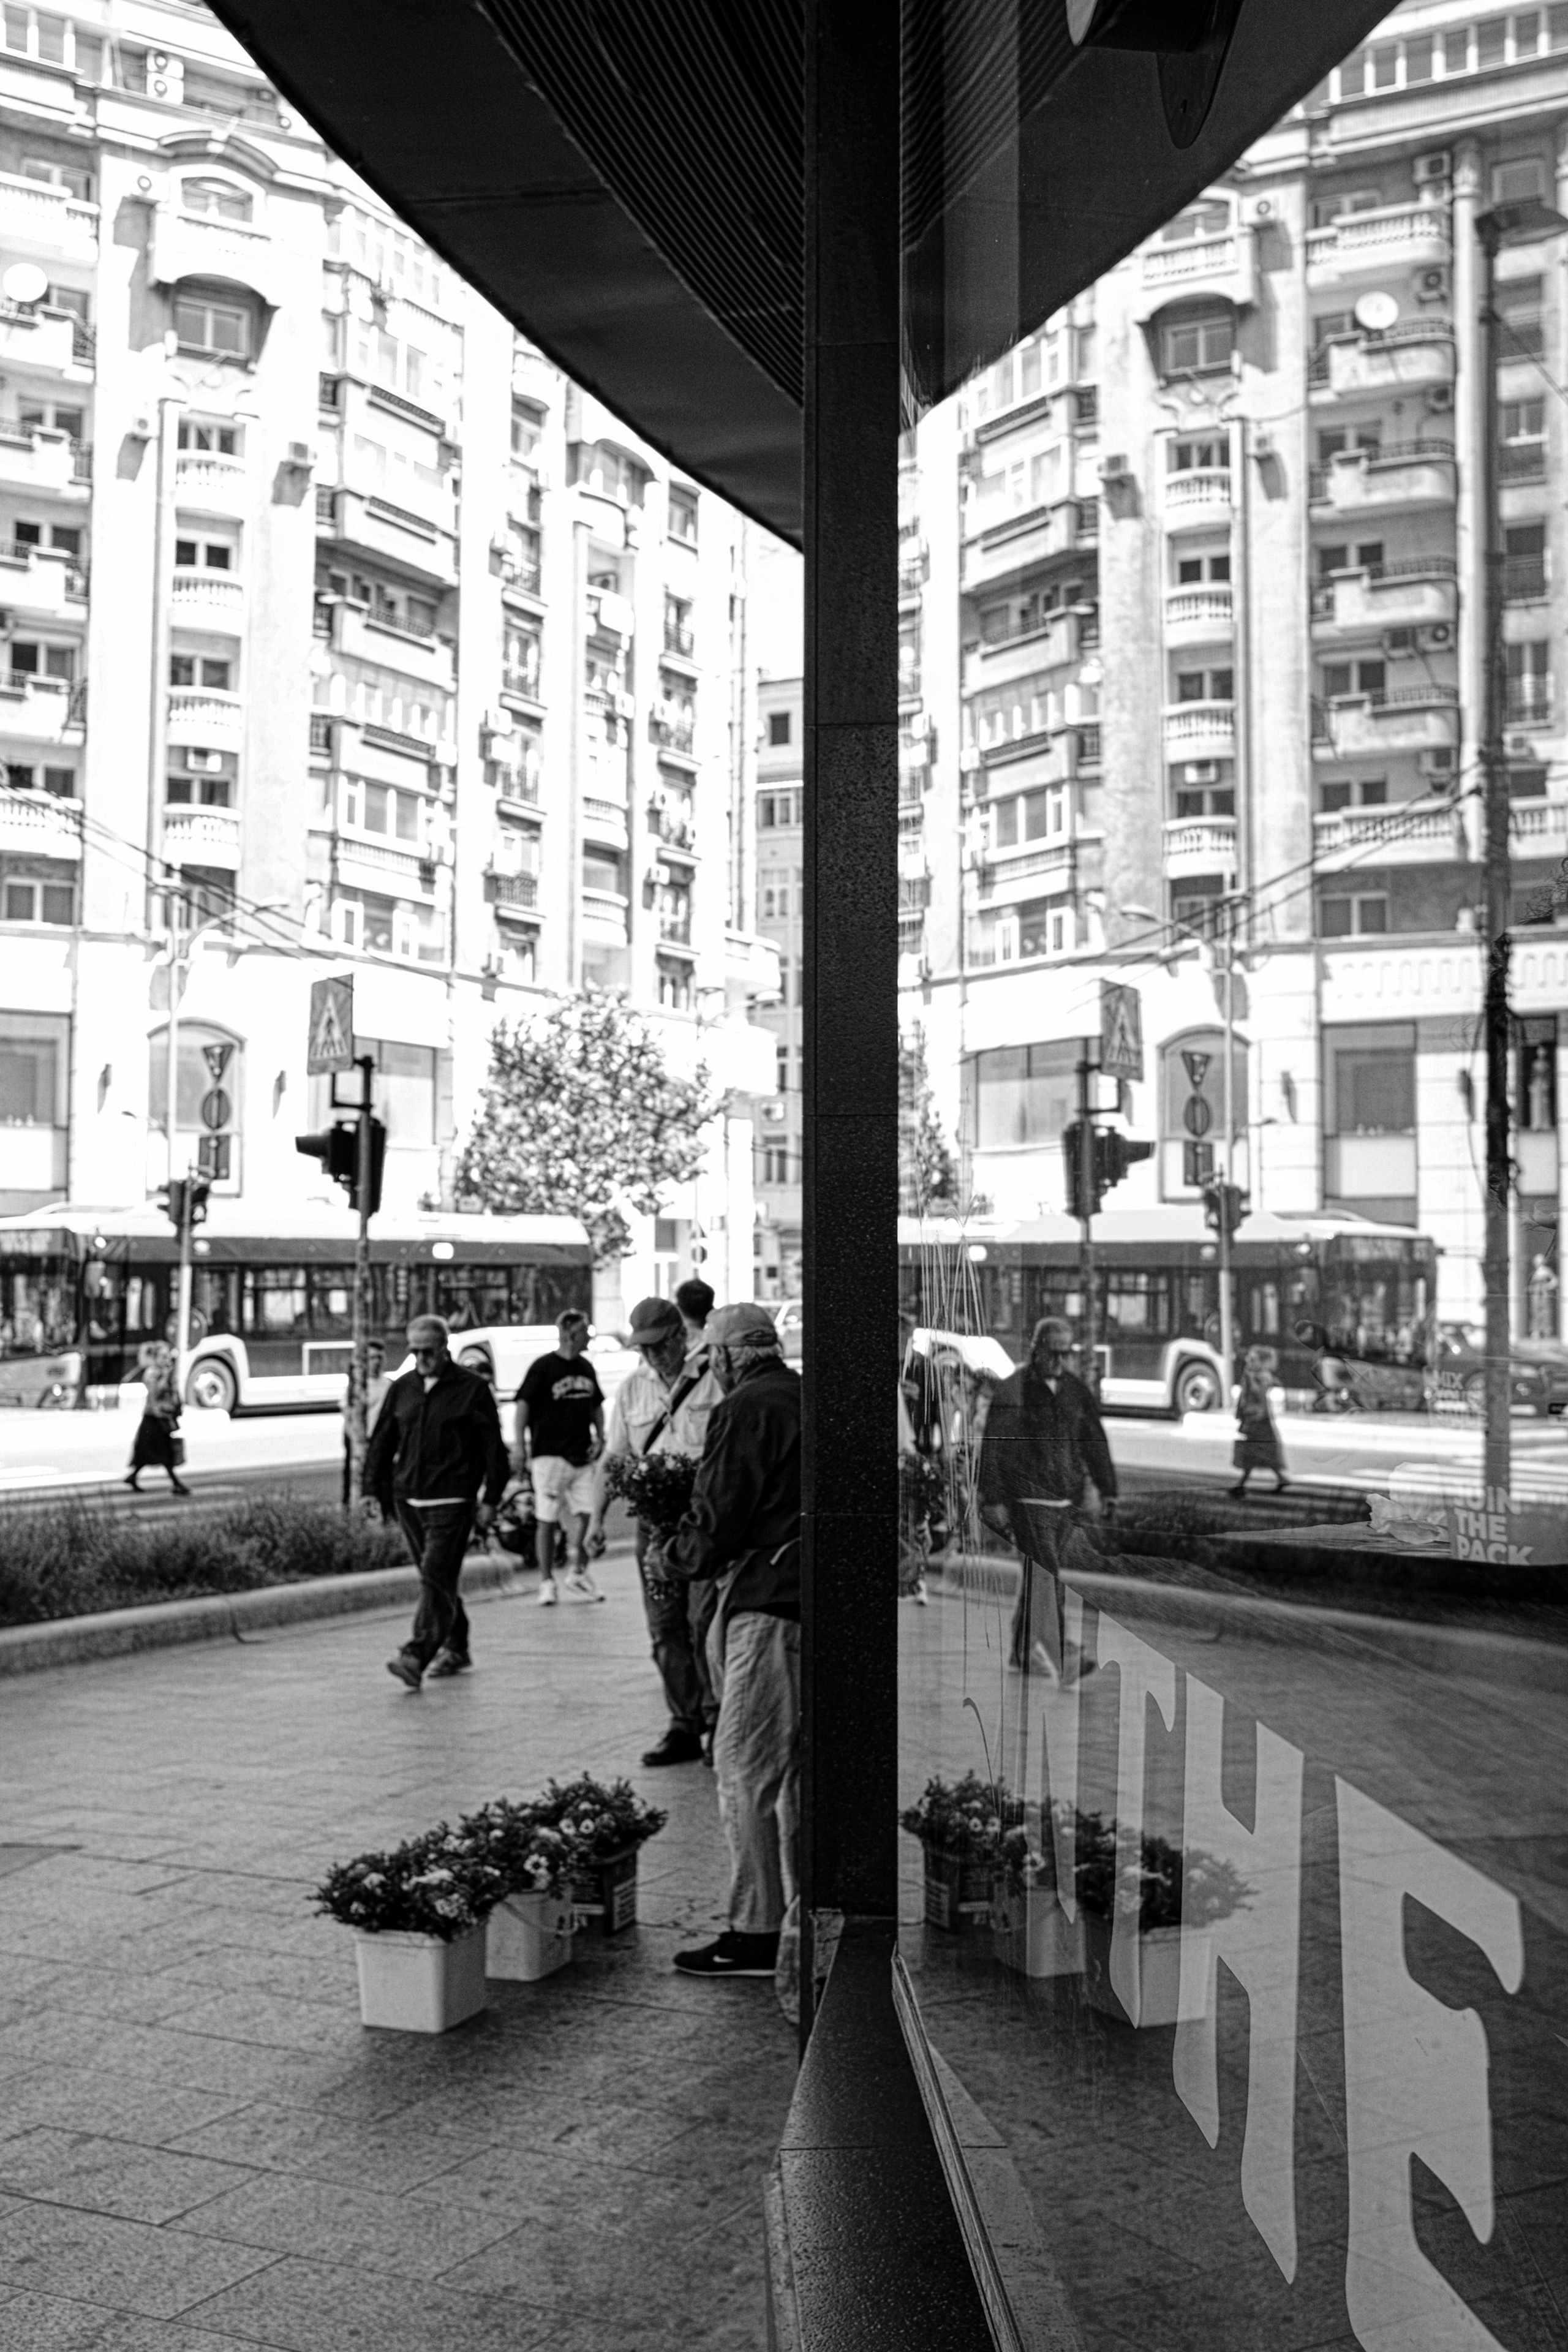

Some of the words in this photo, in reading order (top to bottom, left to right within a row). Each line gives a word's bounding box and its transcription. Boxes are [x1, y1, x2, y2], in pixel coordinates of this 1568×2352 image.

[1453, 1507, 1508, 1543] THE
[1456, 1534, 1534, 1566] PACK
[1097, 1610, 1525, 2351] THE
